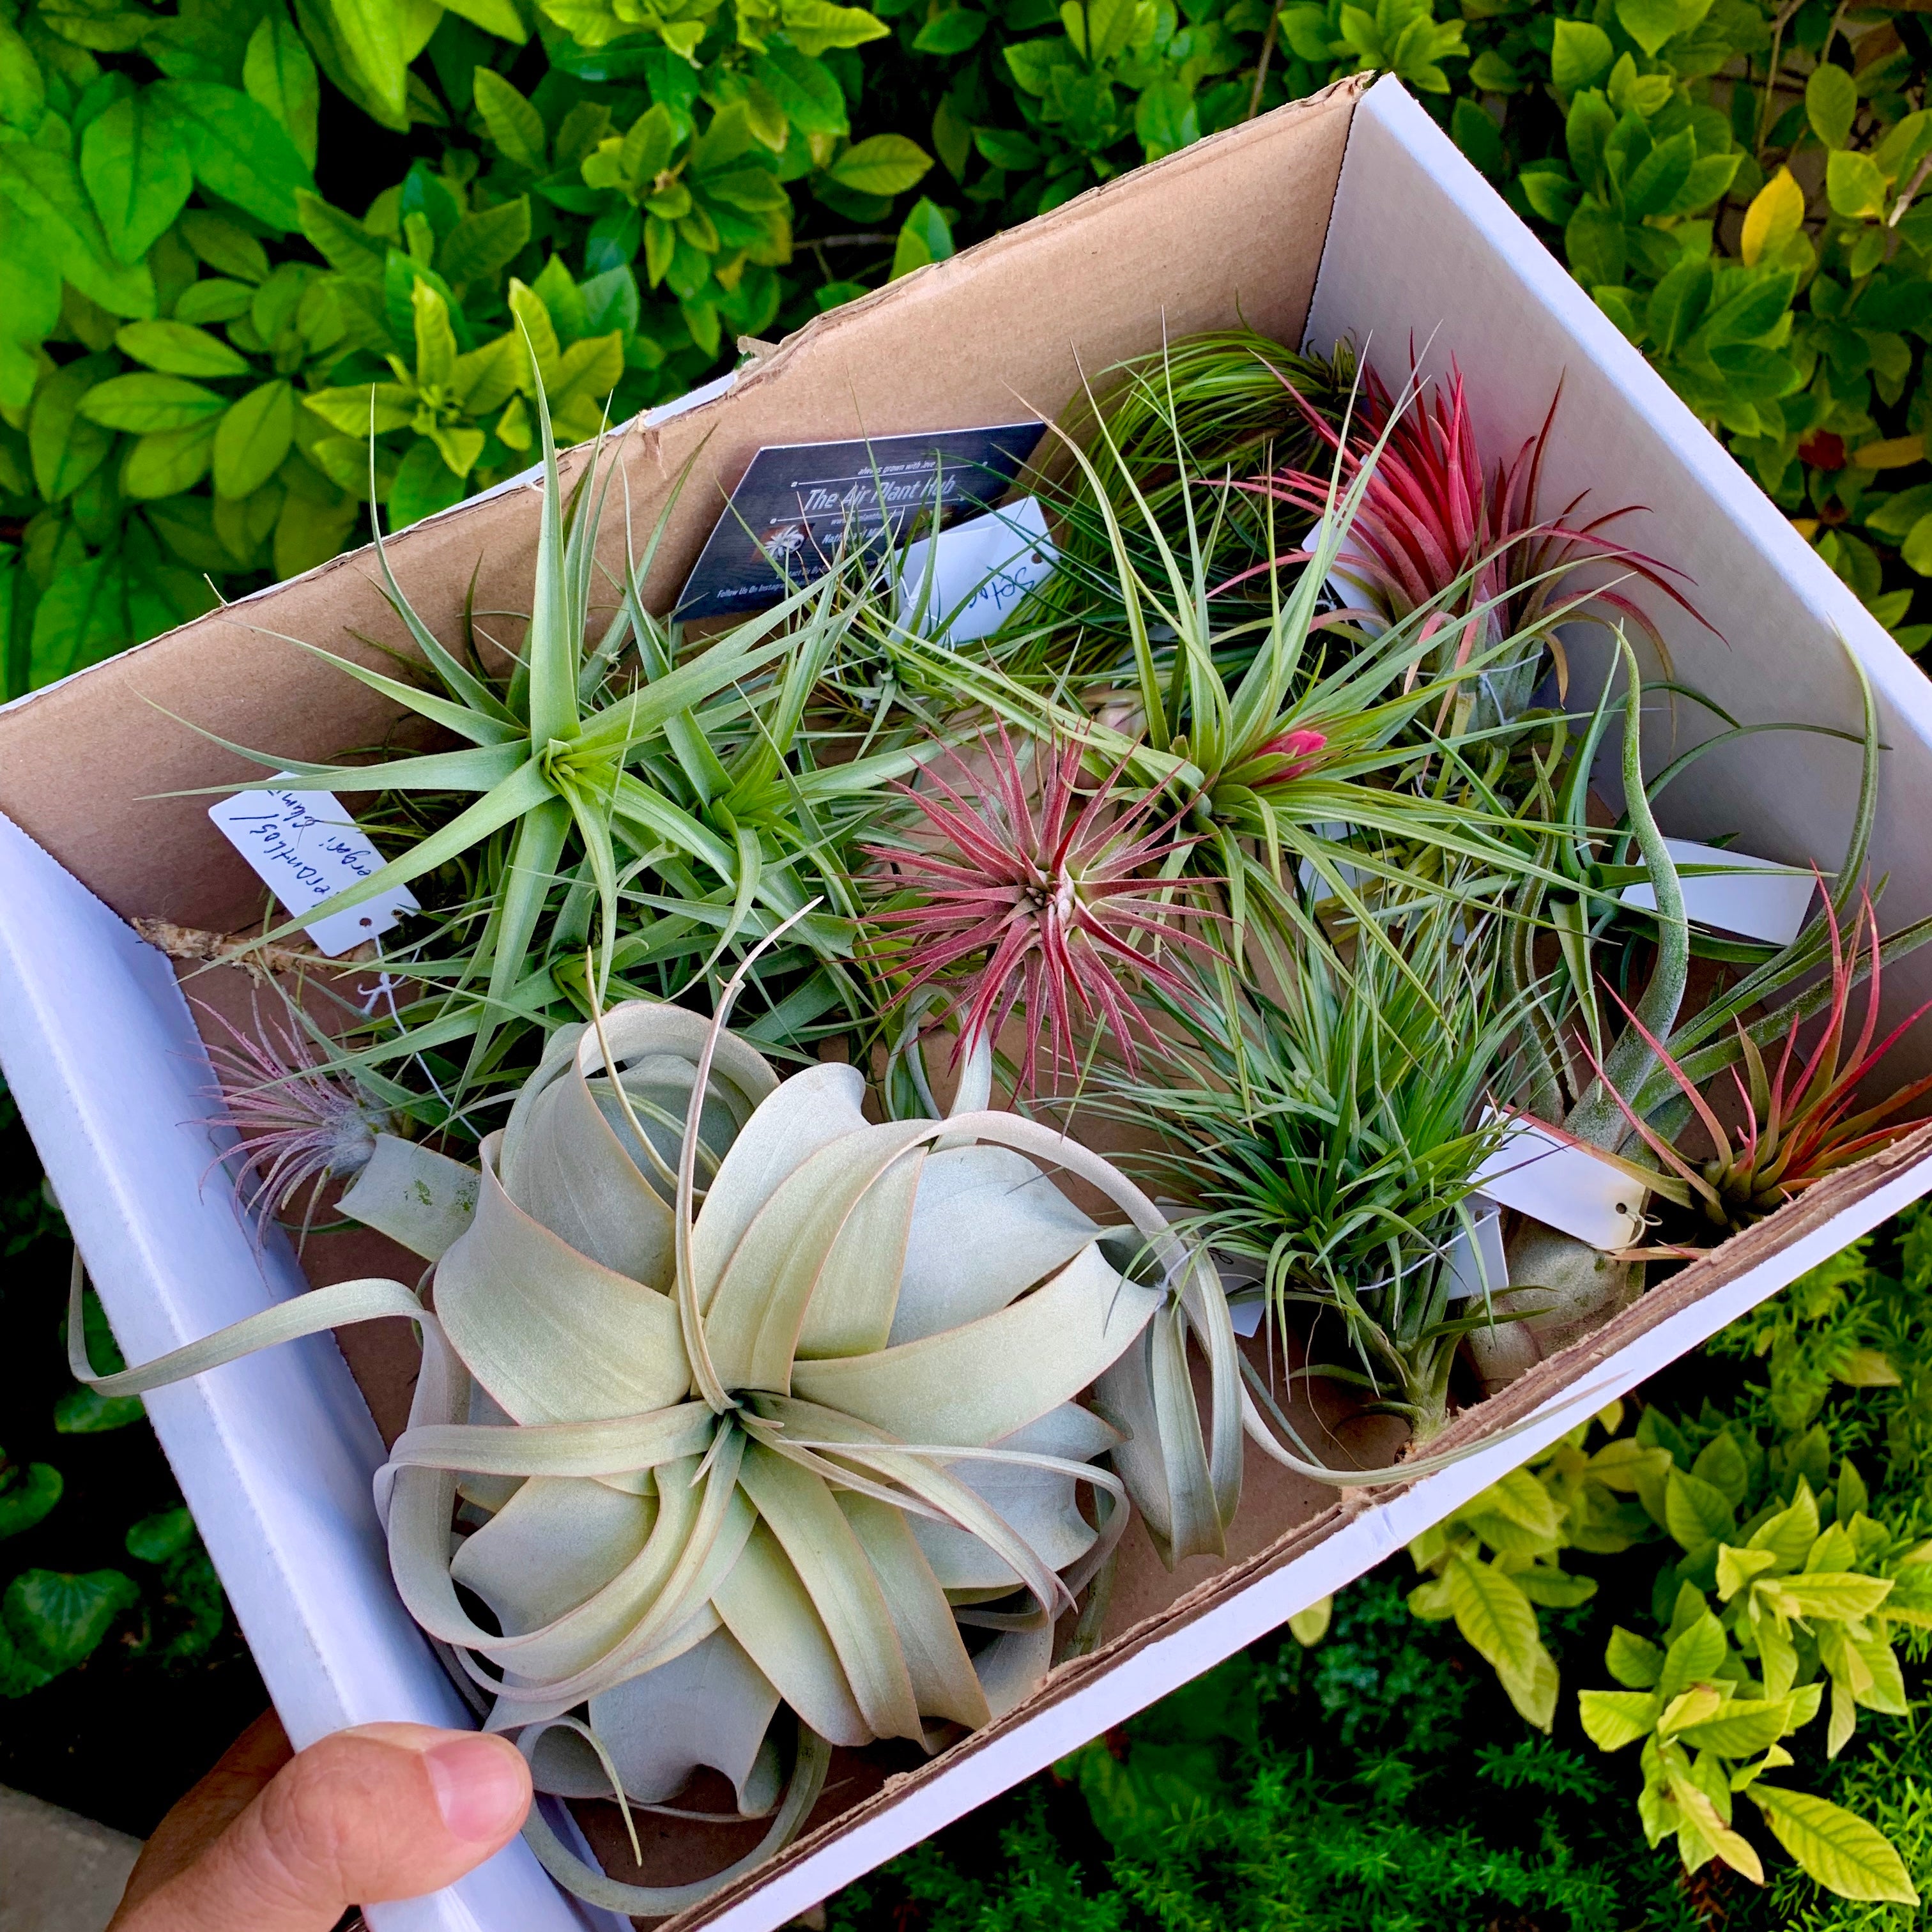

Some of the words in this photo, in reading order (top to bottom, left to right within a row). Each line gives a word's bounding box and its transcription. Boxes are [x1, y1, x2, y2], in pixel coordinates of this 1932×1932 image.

[857, 466, 882, 475] alwas
[882, 464, 905, 473] grown
[905, 461, 921, 470] with
[804, 487, 839, 511] The
[841, 484, 871, 507] Air
[870, 480, 921, 503] Plant
[919, 474, 956, 498] Hub
[717, 588, 739, 598] Follow
[758, 582, 786, 592] Instagra
